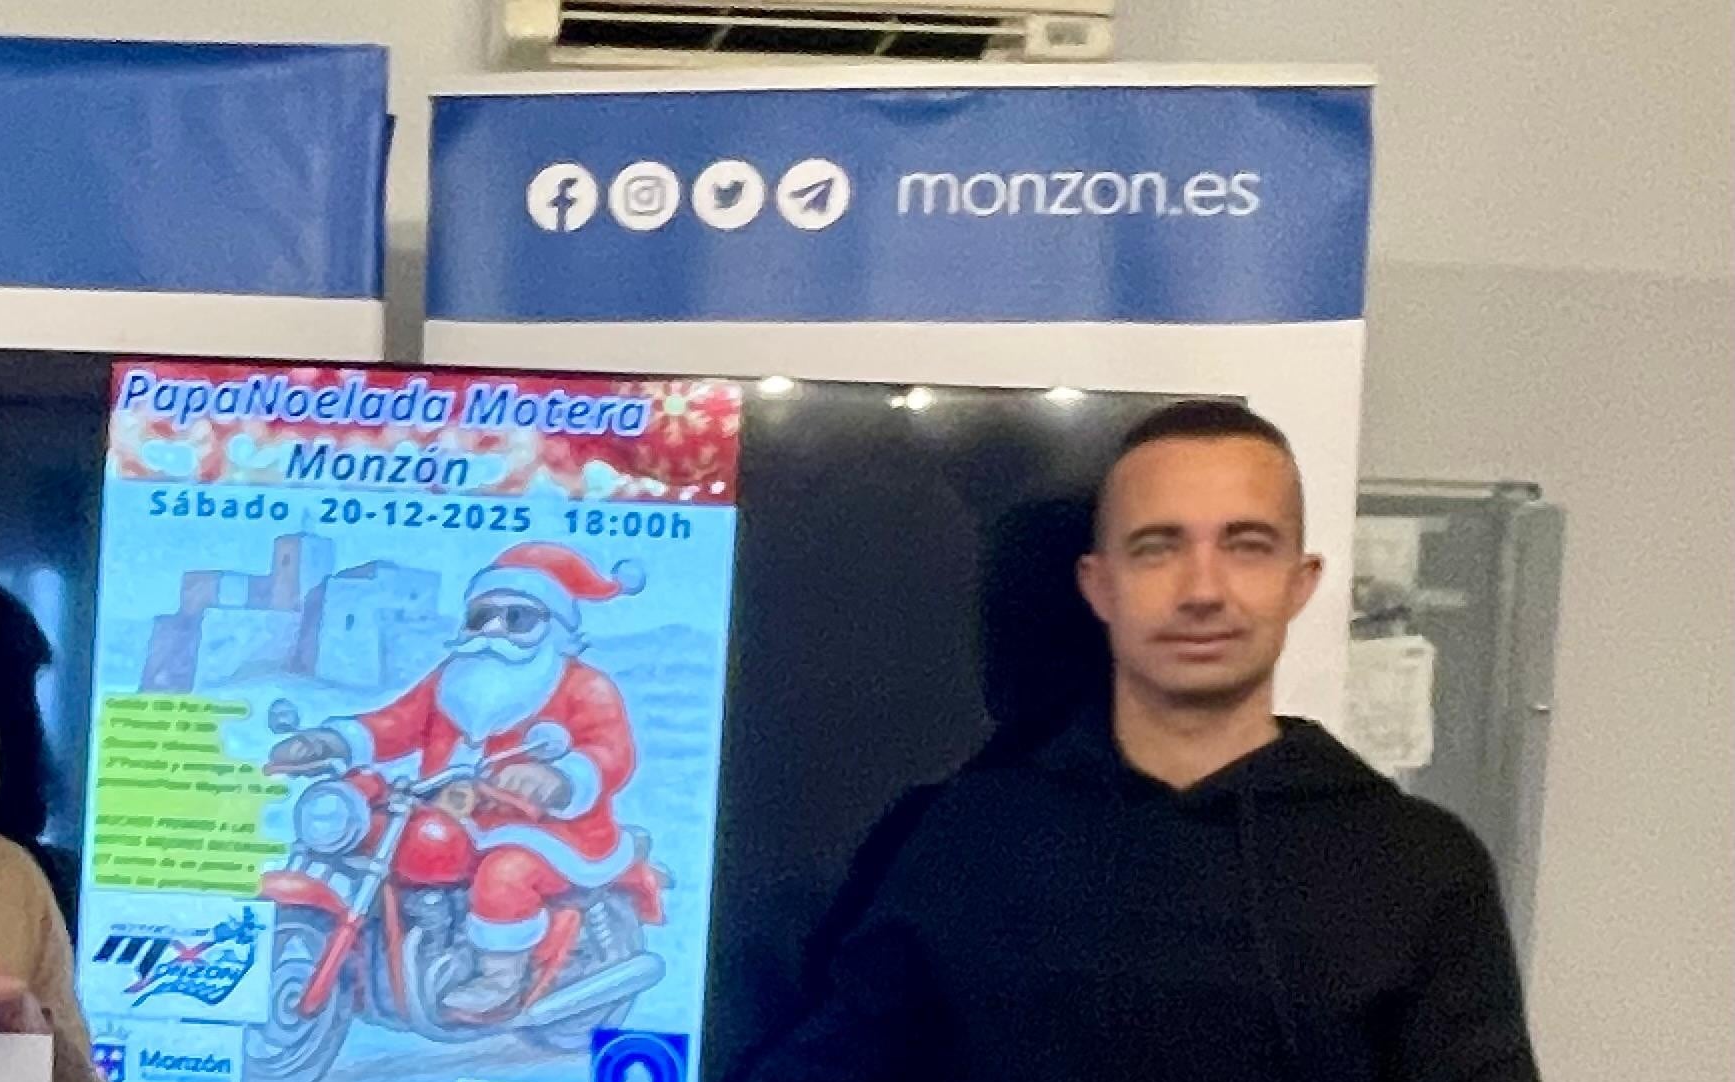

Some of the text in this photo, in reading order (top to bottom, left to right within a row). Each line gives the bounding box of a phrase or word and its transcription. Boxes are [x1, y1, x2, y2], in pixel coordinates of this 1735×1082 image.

[896, 169, 1262, 218] monzon.es
[121, 373, 647, 434] PapaNoelada Motera
[285, 443, 472, 487] Monzón
[149, 490, 693, 540] Sábado 20-12-2025 18:00h
